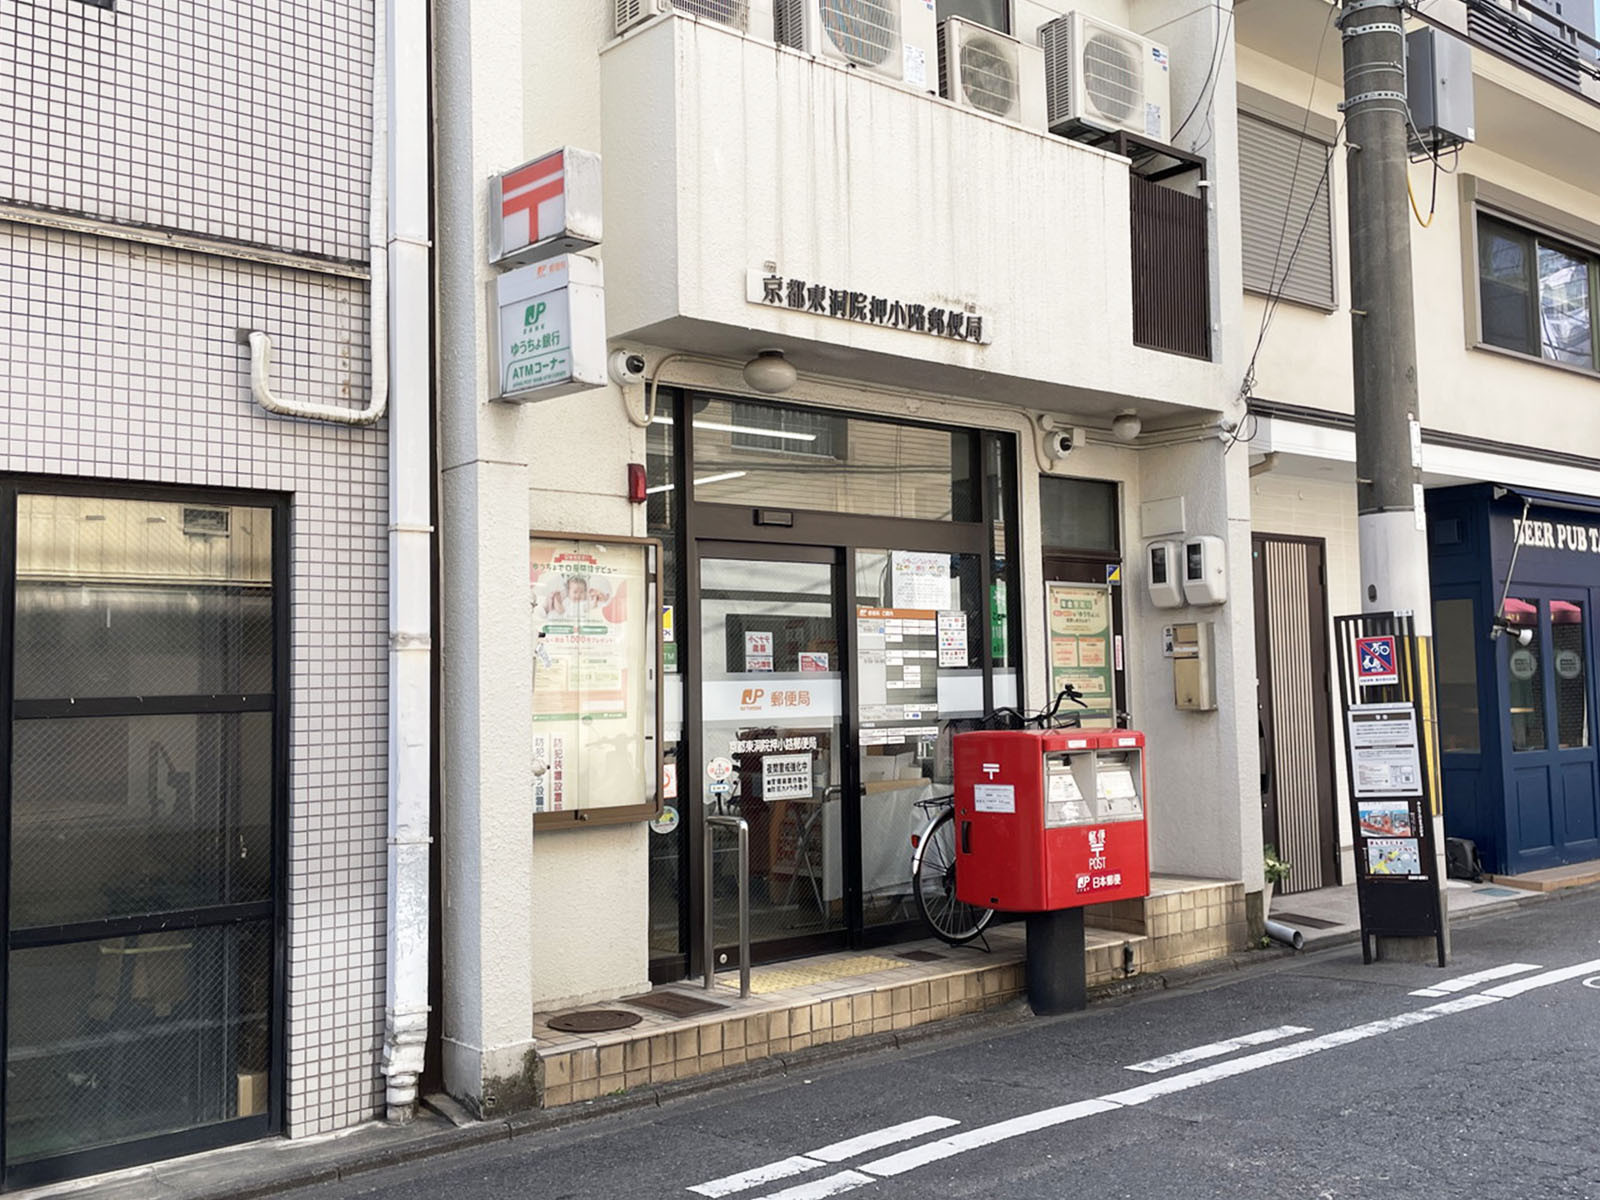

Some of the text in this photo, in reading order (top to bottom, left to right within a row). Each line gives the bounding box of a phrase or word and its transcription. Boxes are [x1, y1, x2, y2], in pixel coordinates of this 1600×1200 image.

[762, 275, 983, 343] 京都東洞院押小路郵便局
[511, 331, 560, 357] ゆうちょ銀行
[512, 357, 566, 380] ATMコーナー
[1513, 519, 1555, 549] BEER
[1556, 524, 1588, 552] PUB
[663, 652, 675, 660] TM
[770, 690, 811, 707] 郵便局
[1088, 829, 1106, 845] 郵便
[1088, 856, 1106, 870] POST
[1092, 873, 1122, 889] 日本郵便
